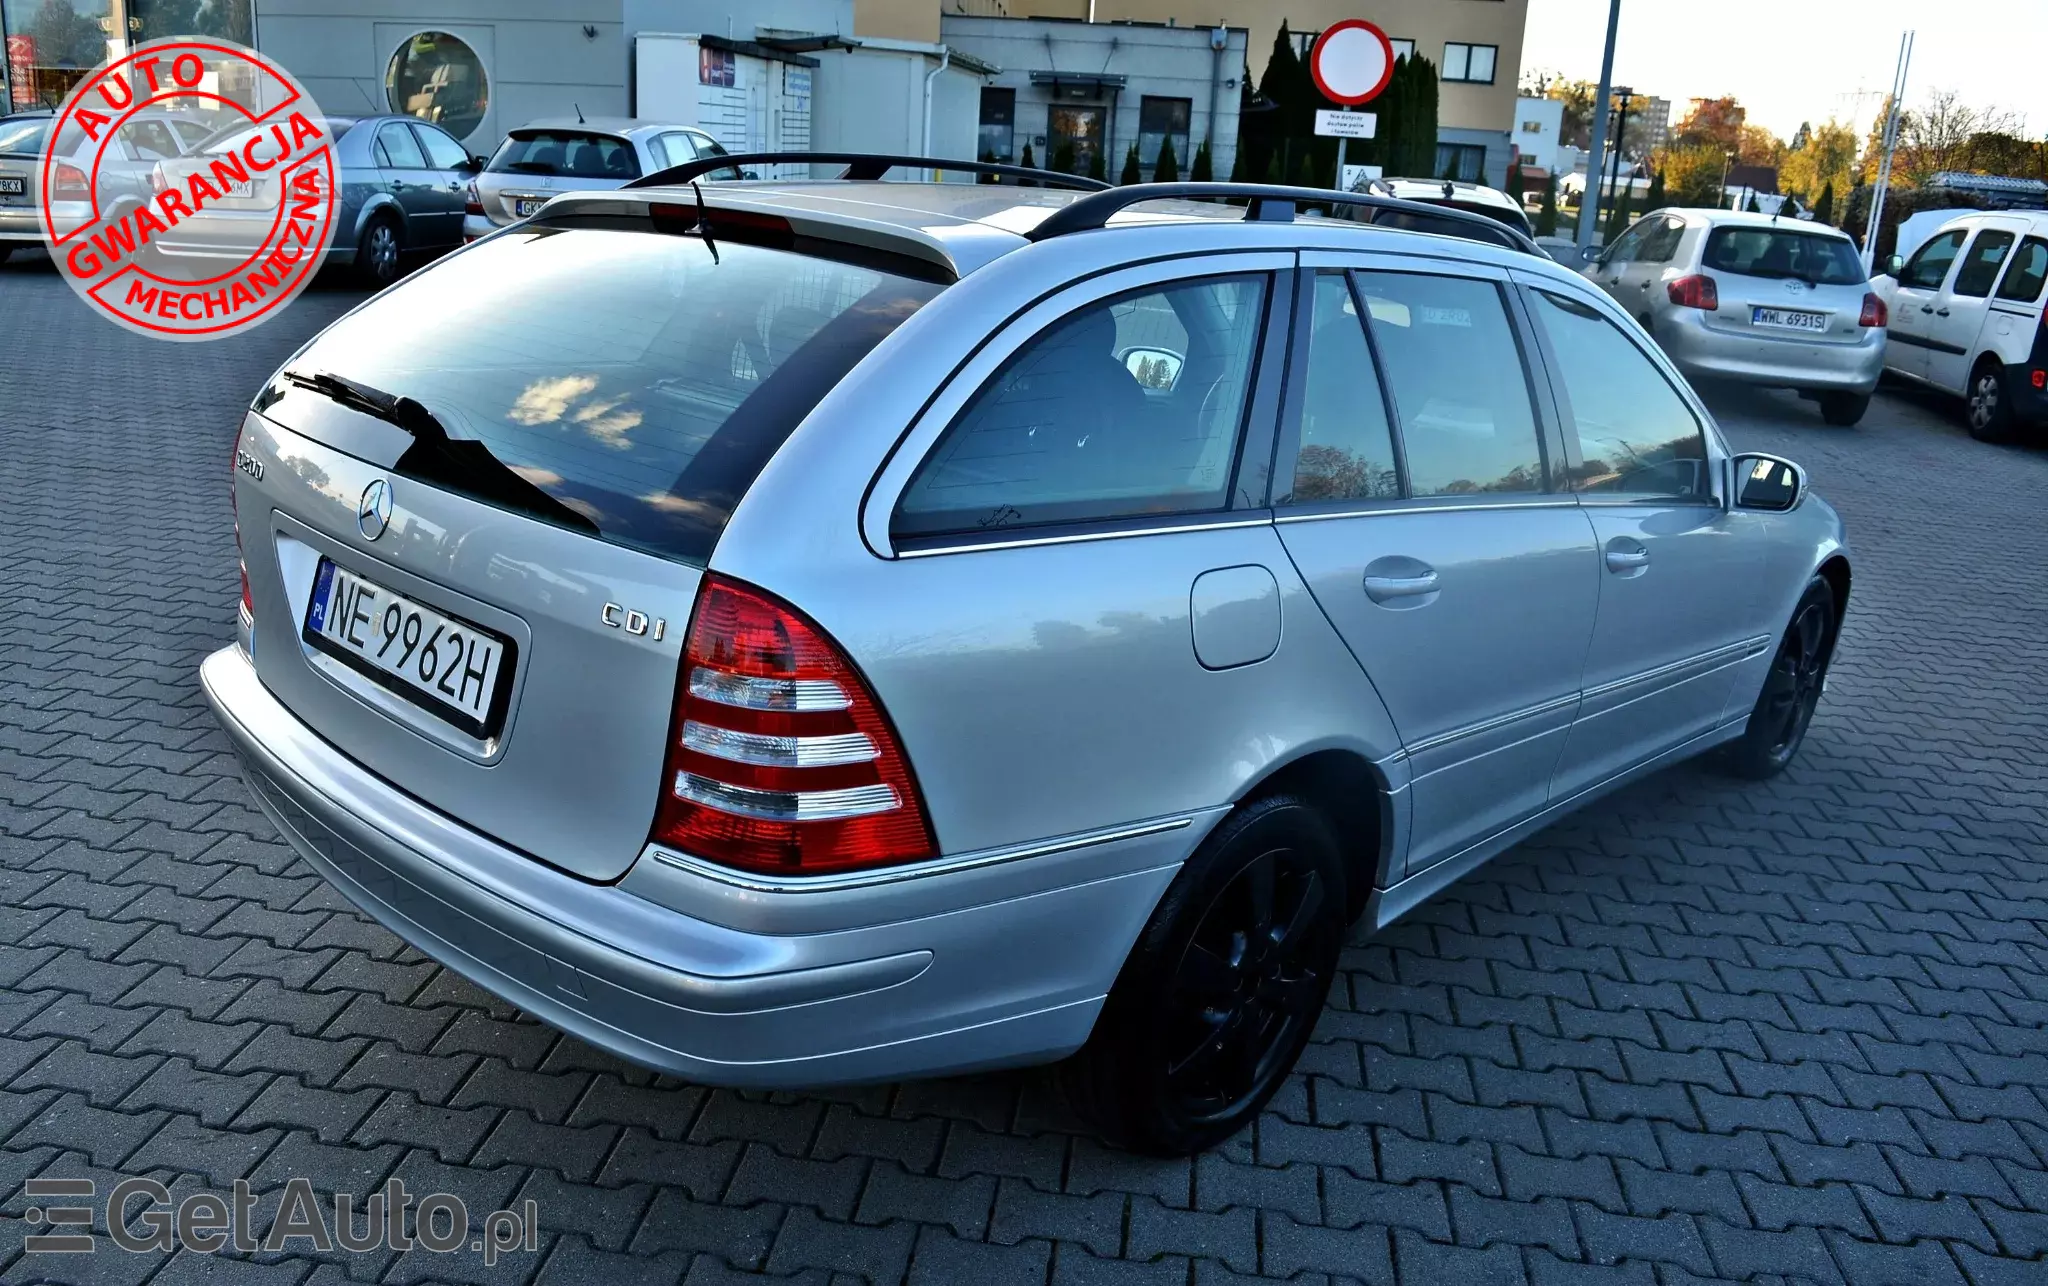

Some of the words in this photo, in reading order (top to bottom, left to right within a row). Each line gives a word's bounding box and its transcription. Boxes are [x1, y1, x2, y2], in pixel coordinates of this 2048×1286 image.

[0, 180, 20, 192] 8KX
[1760, 310, 1783, 325] WWL
[1786, 313, 1823, 329] 6931S
[313, 602, 324, 621] PL
[601, 601, 667, 642] CDI
[328, 576, 376, 649] NE
[377, 601, 492, 711] 9962H
